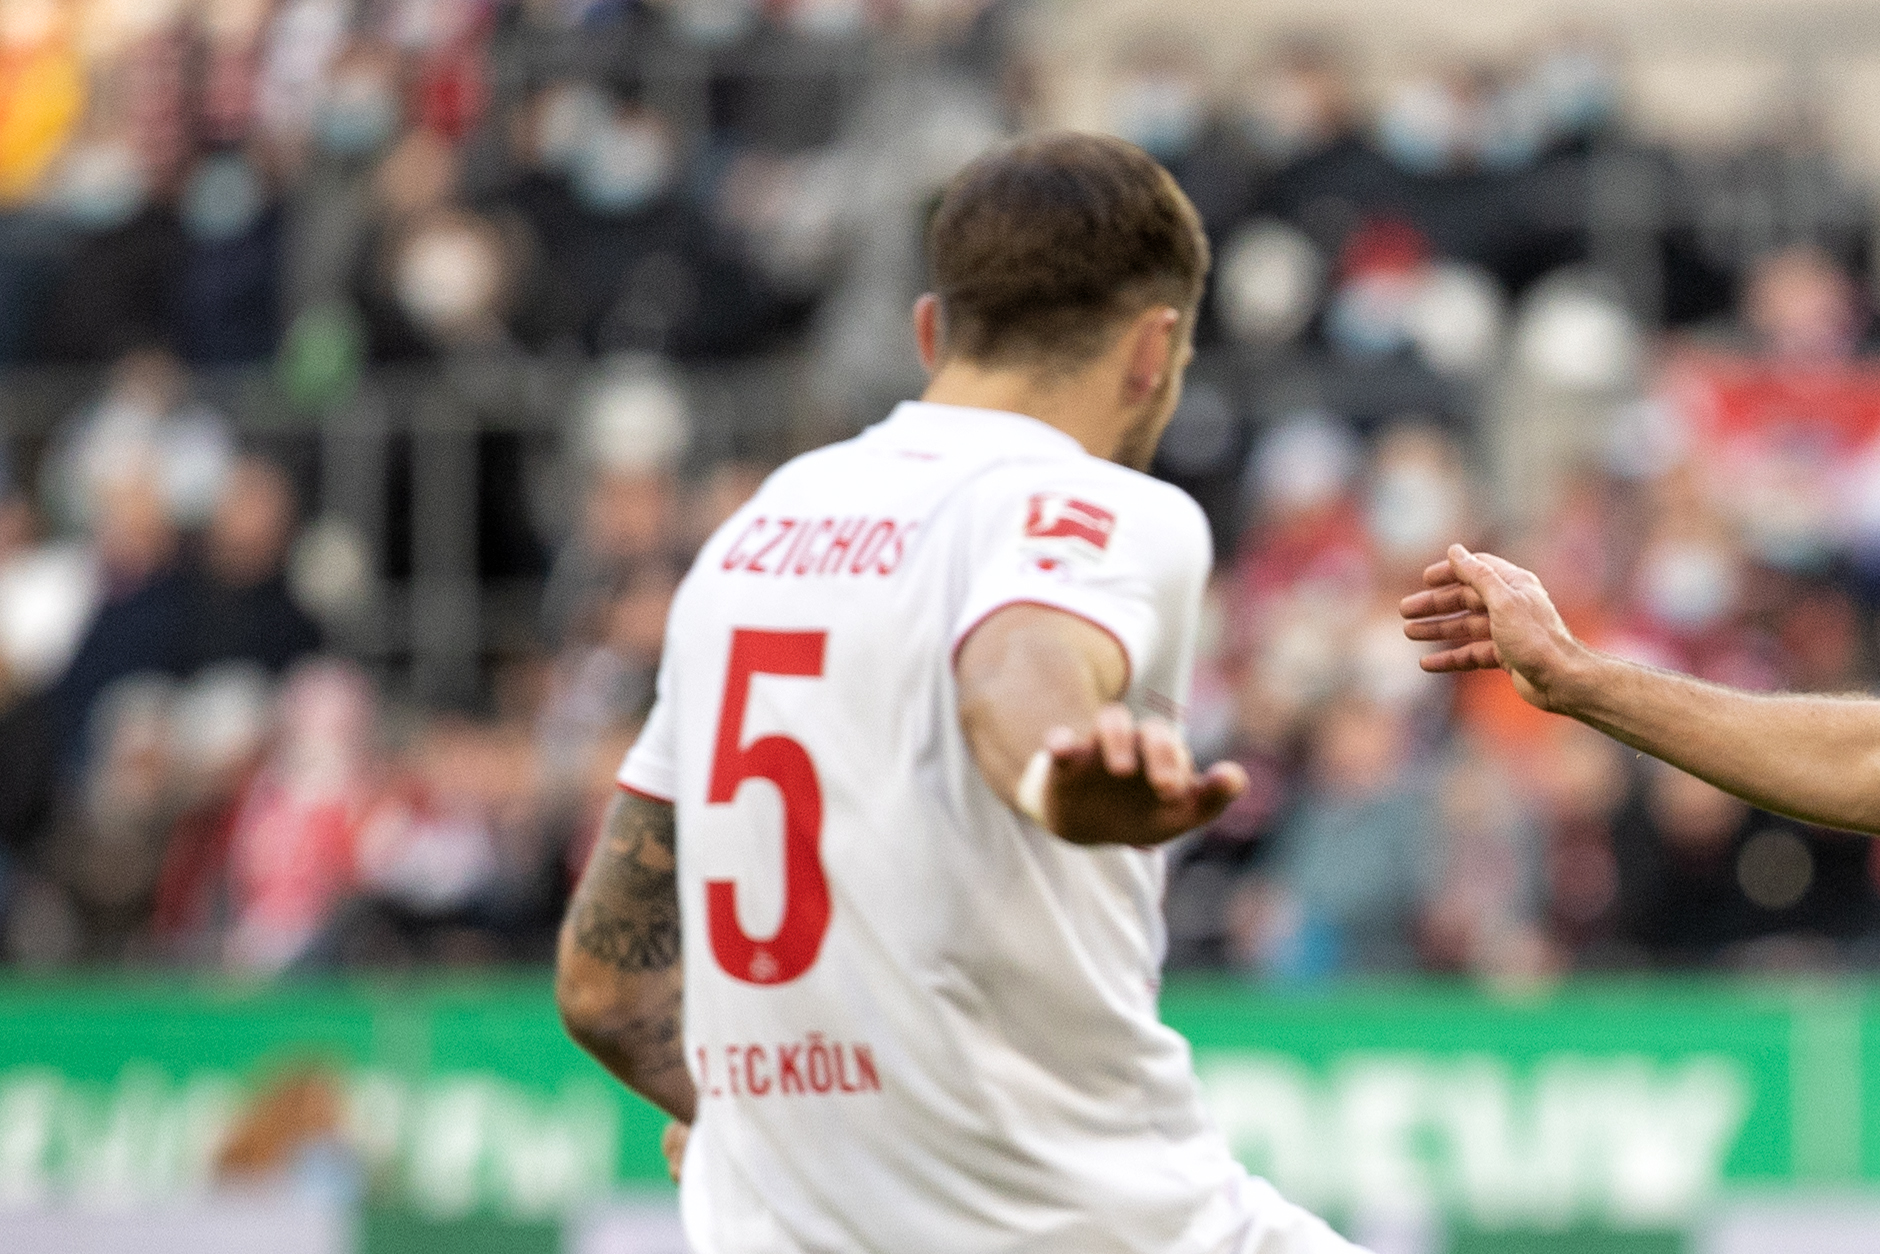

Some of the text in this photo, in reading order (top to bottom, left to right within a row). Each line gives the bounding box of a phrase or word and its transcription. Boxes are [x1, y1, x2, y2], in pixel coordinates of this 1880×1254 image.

[721, 515, 921, 577] CZICHOS
[705, 628, 832, 986] 5
[726, 1045, 771, 1096] FC
